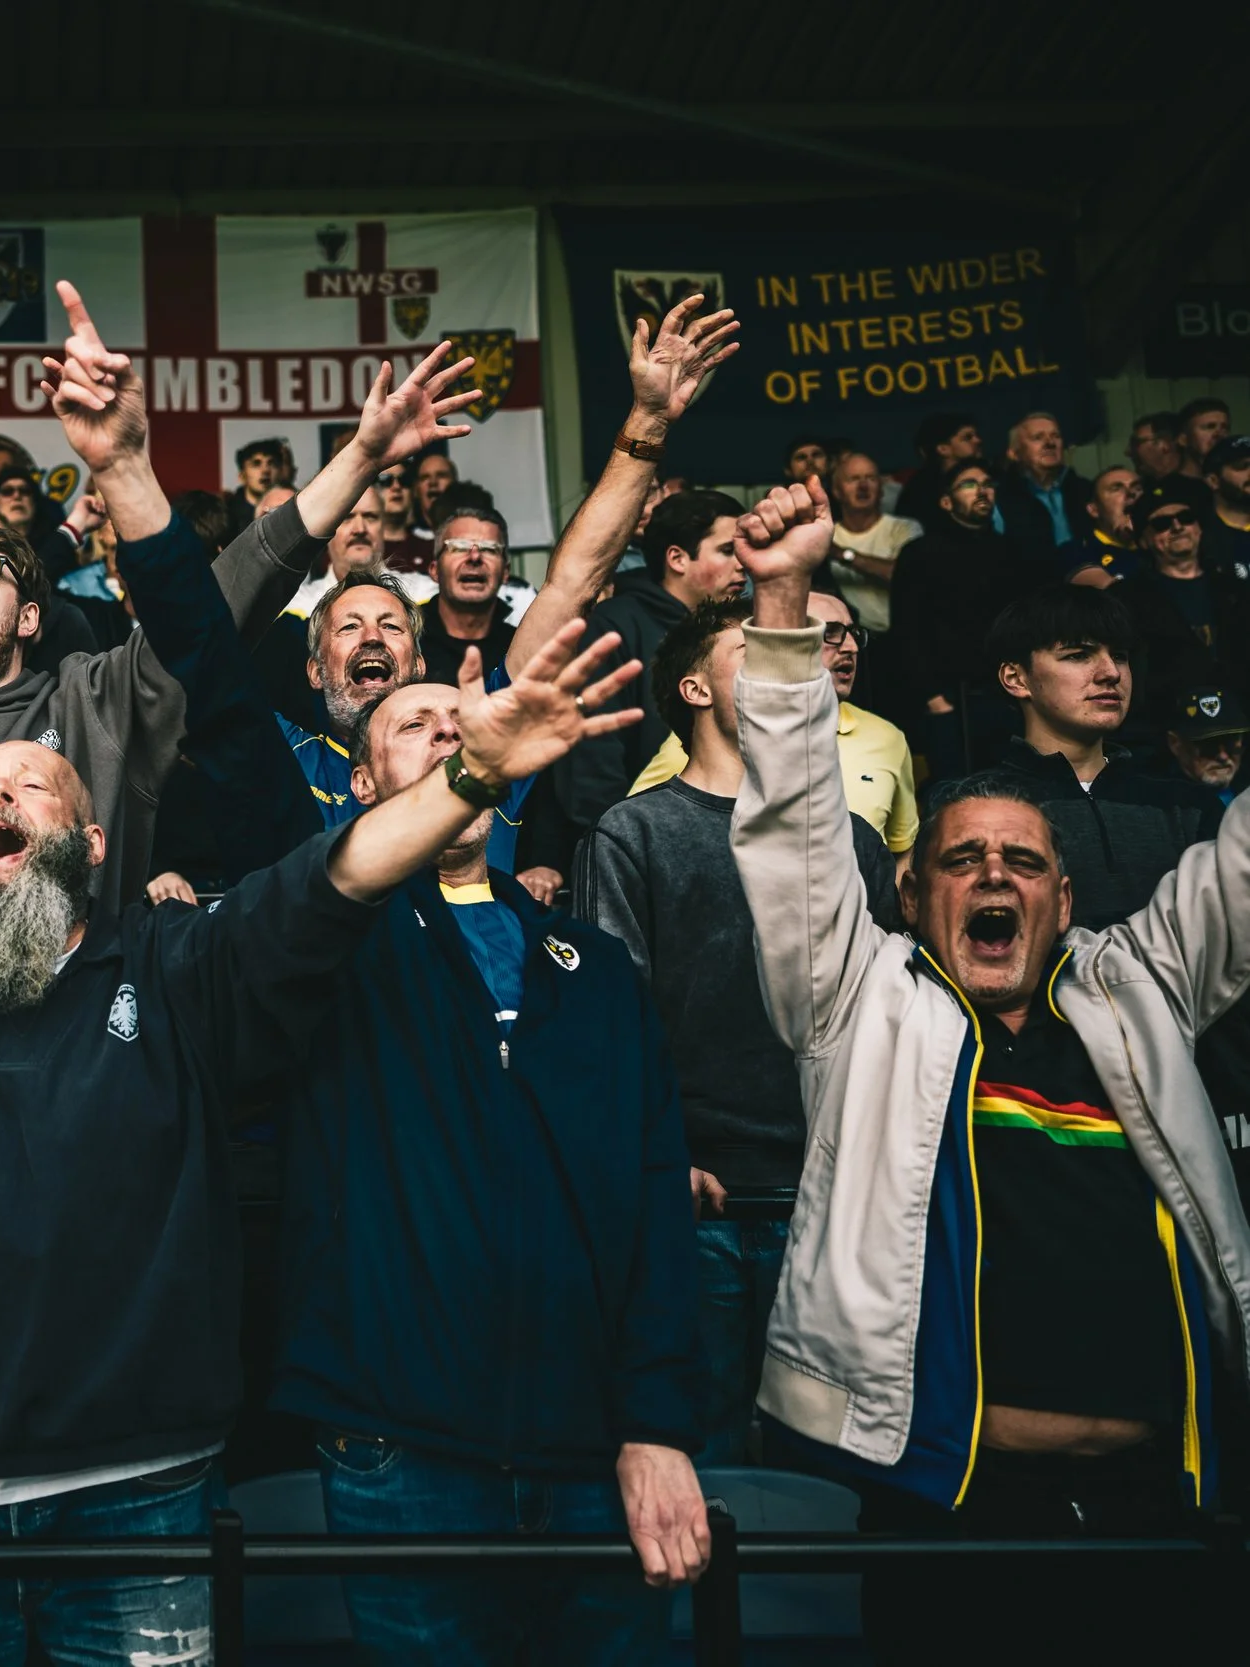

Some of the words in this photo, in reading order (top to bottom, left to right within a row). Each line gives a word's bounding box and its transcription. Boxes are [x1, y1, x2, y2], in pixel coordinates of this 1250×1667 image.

[320, 271, 424, 296] NWSG
[756, 275, 798, 308] IN
[811, 268, 897, 304] THE
[906, 247, 1047, 296] WIDER
[787, 300, 1024, 356] INTERESTS
[130, 352, 434, 412] MBLEDO
[765, 369, 822, 405] OF
[837, 346, 1059, 401] FOOTBALL
